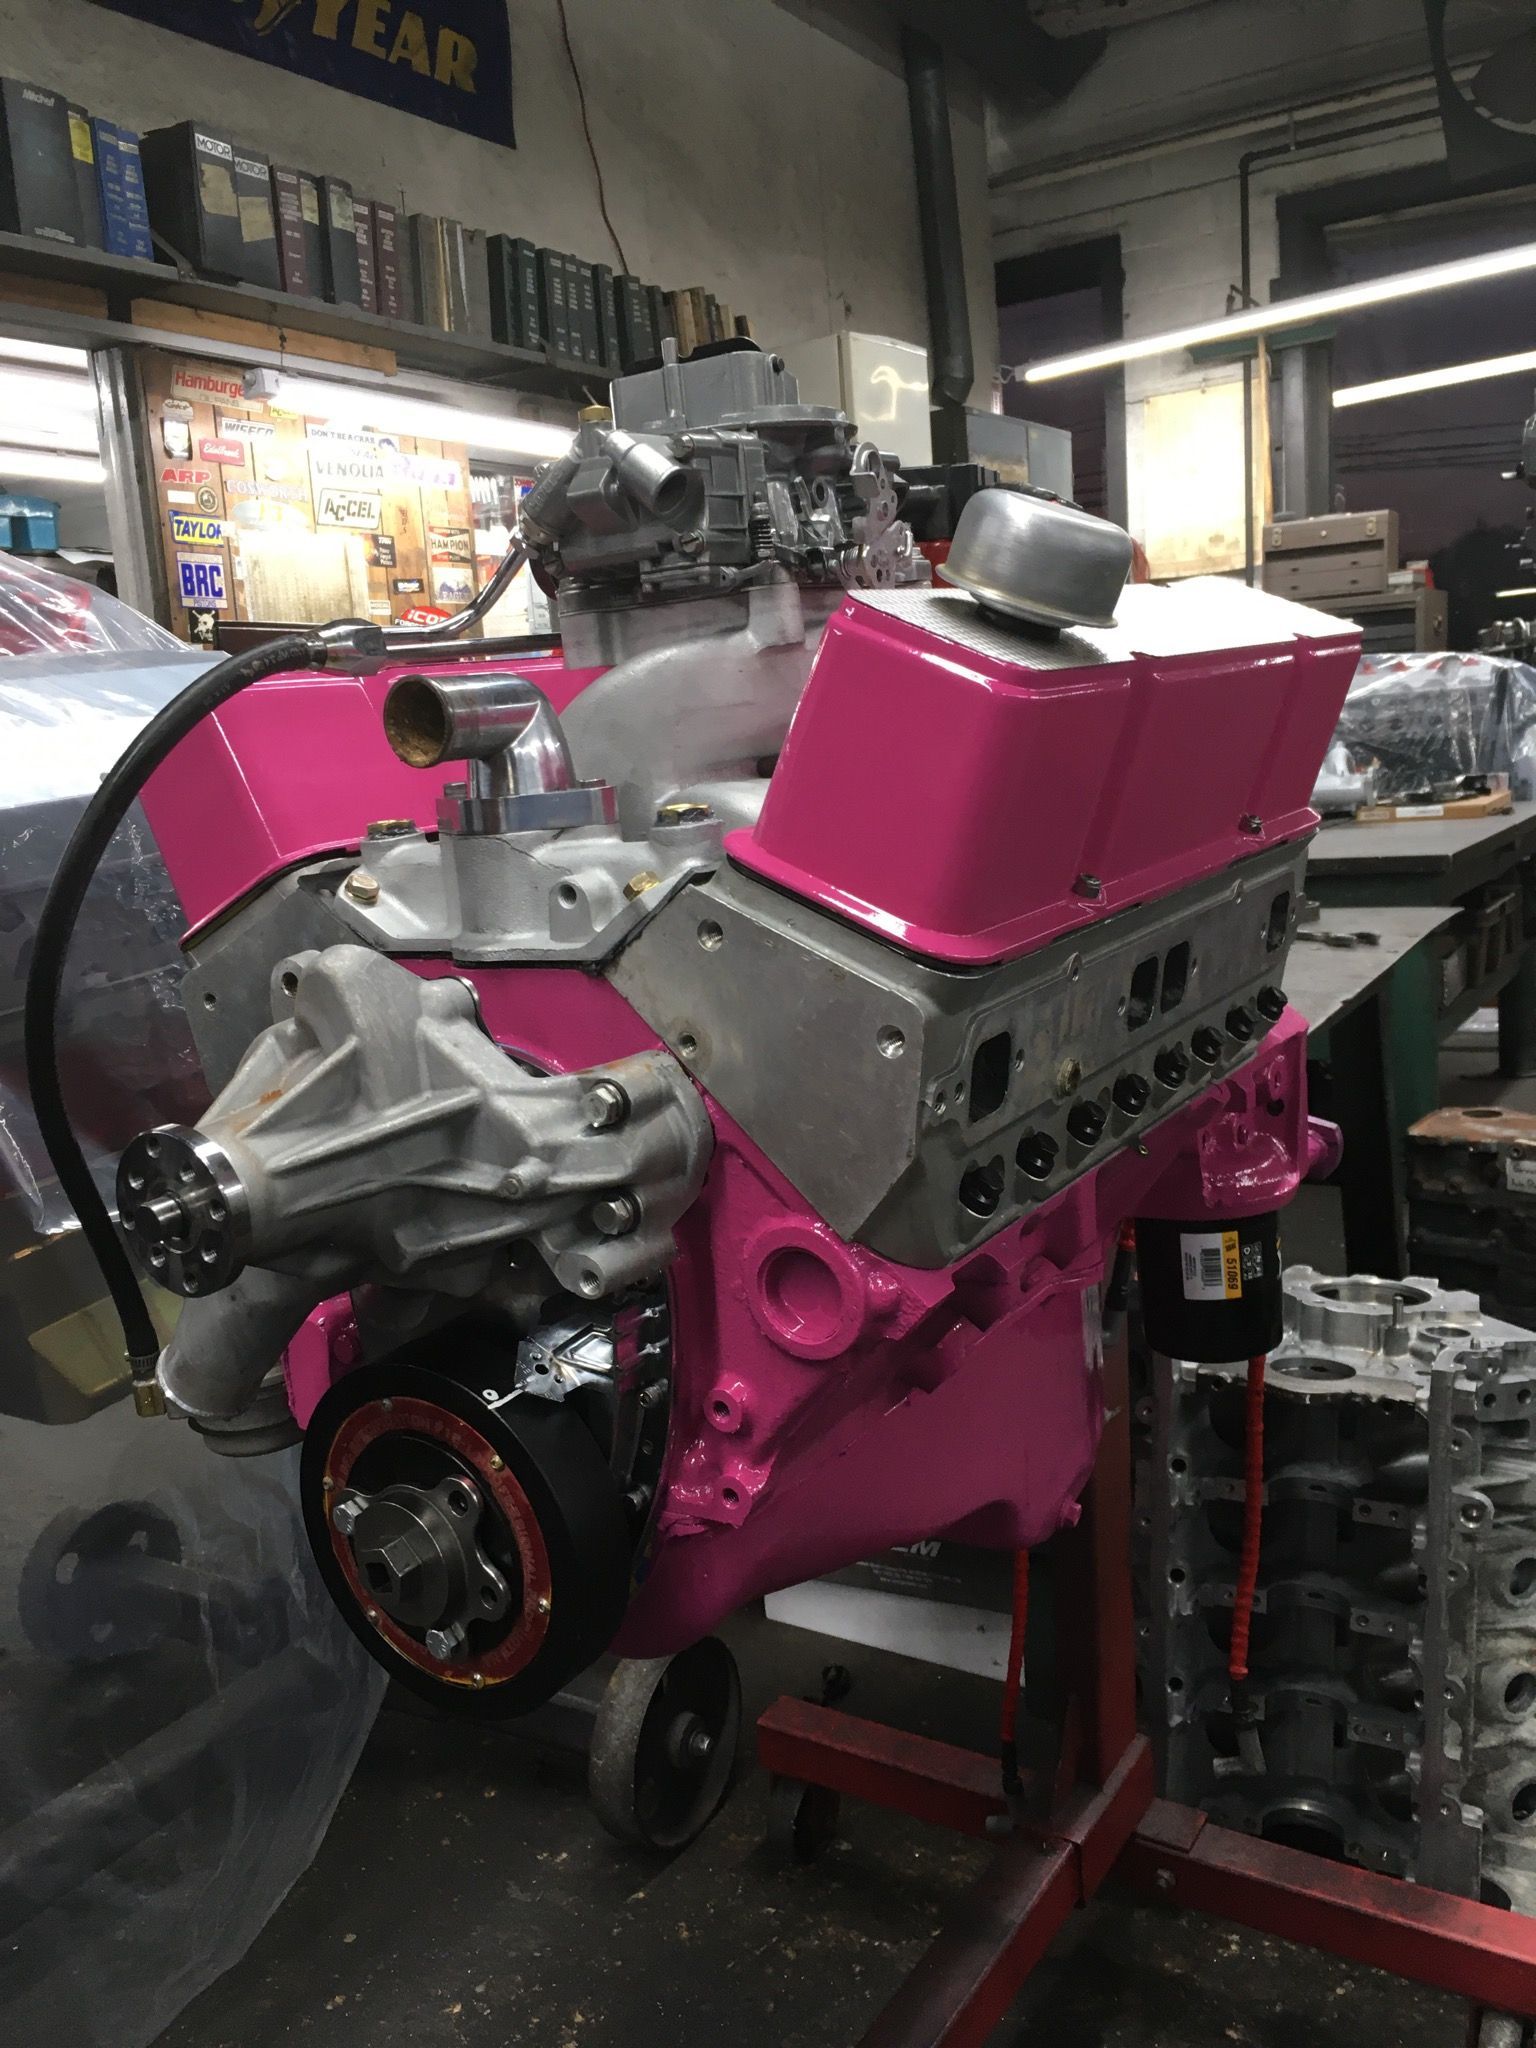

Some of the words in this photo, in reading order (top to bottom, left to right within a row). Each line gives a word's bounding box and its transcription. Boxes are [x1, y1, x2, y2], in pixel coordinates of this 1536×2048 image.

[196, 135, 232, 157] MOTOR
[234, 159, 267, 178] MOTOR
[174, 370, 246, 398] Hamburge
[160, 468, 212, 484] ARP
[316, 461, 384, 479] VENOLIA
[430, 538, 470, 552] HAMPION
[181, 562, 222, 598] BRC
[1226, 1257, 1239, 1290] 51069
